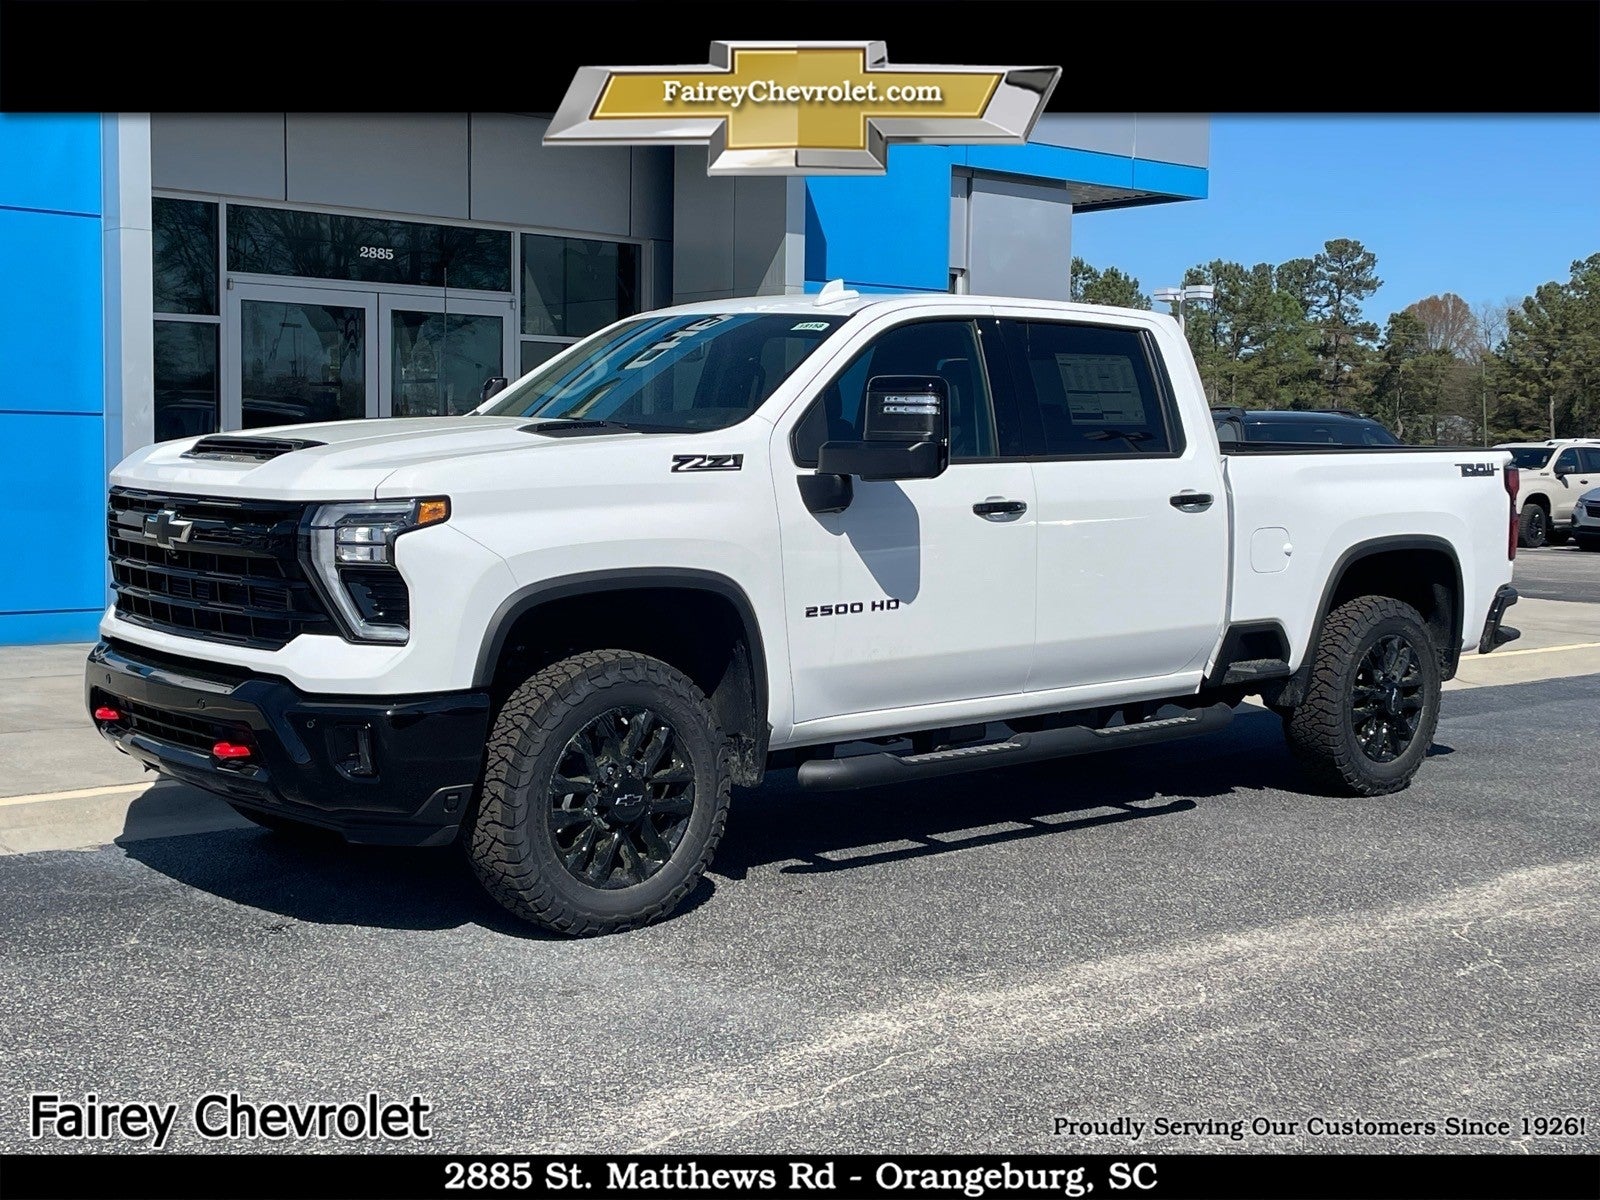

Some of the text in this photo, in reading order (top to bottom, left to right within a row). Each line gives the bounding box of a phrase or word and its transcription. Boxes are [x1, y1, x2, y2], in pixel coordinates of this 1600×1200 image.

[360, 246, 394, 260] 2885
[805, 598, 900, 618] 2500 HD
